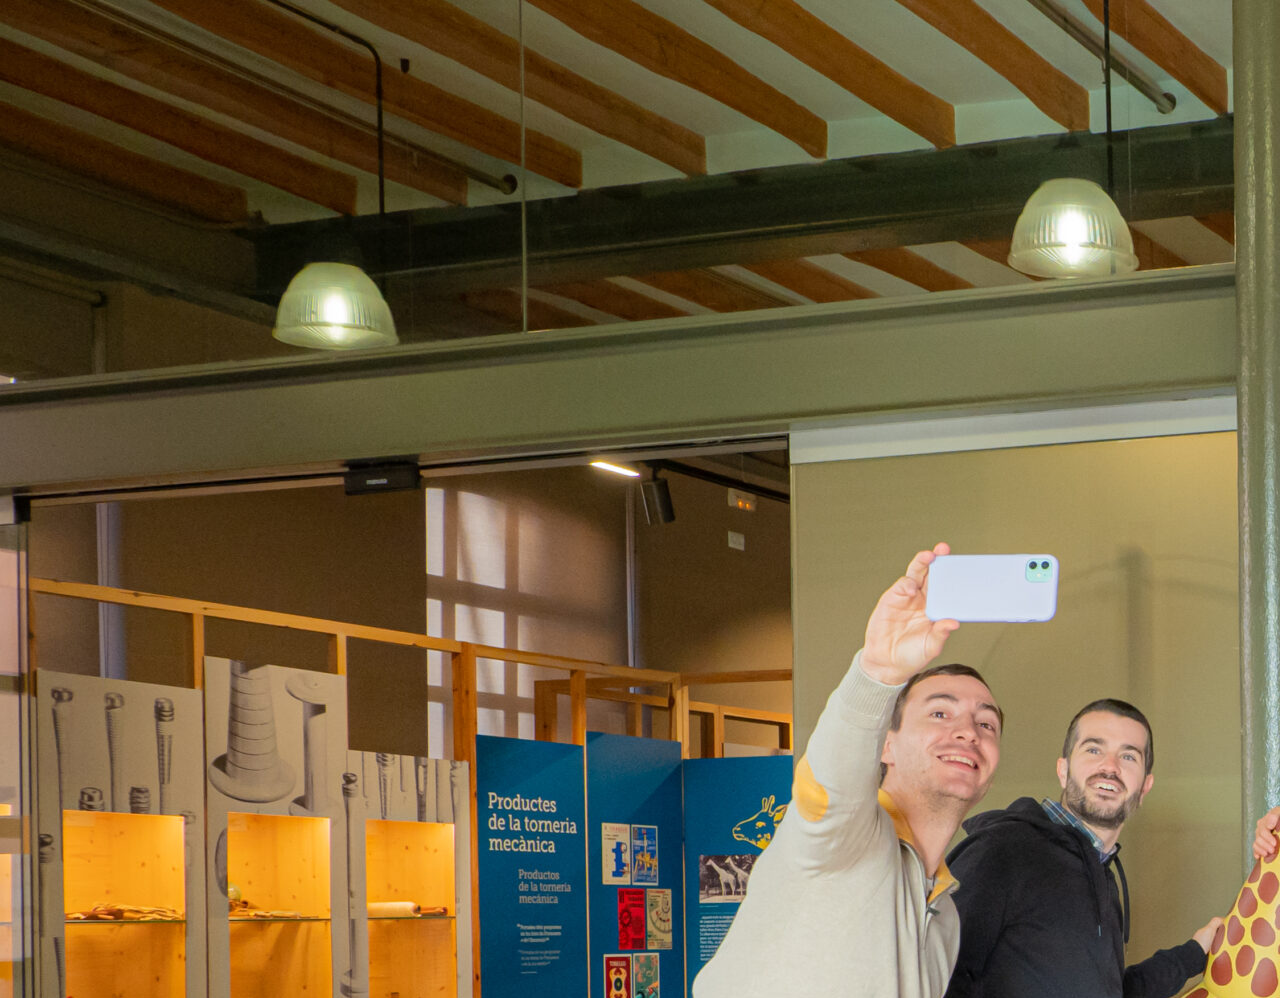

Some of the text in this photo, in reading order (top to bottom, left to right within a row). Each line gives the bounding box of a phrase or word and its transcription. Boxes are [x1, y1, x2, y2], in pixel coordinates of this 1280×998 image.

[488, 791, 557, 813] Productes
[488, 813, 578, 834] de la torneria
[488, 835, 556, 853] mecànica
[518, 868, 560, 880] Productos
[518, 881, 529, 892] de
[530, 881, 538, 892] la
